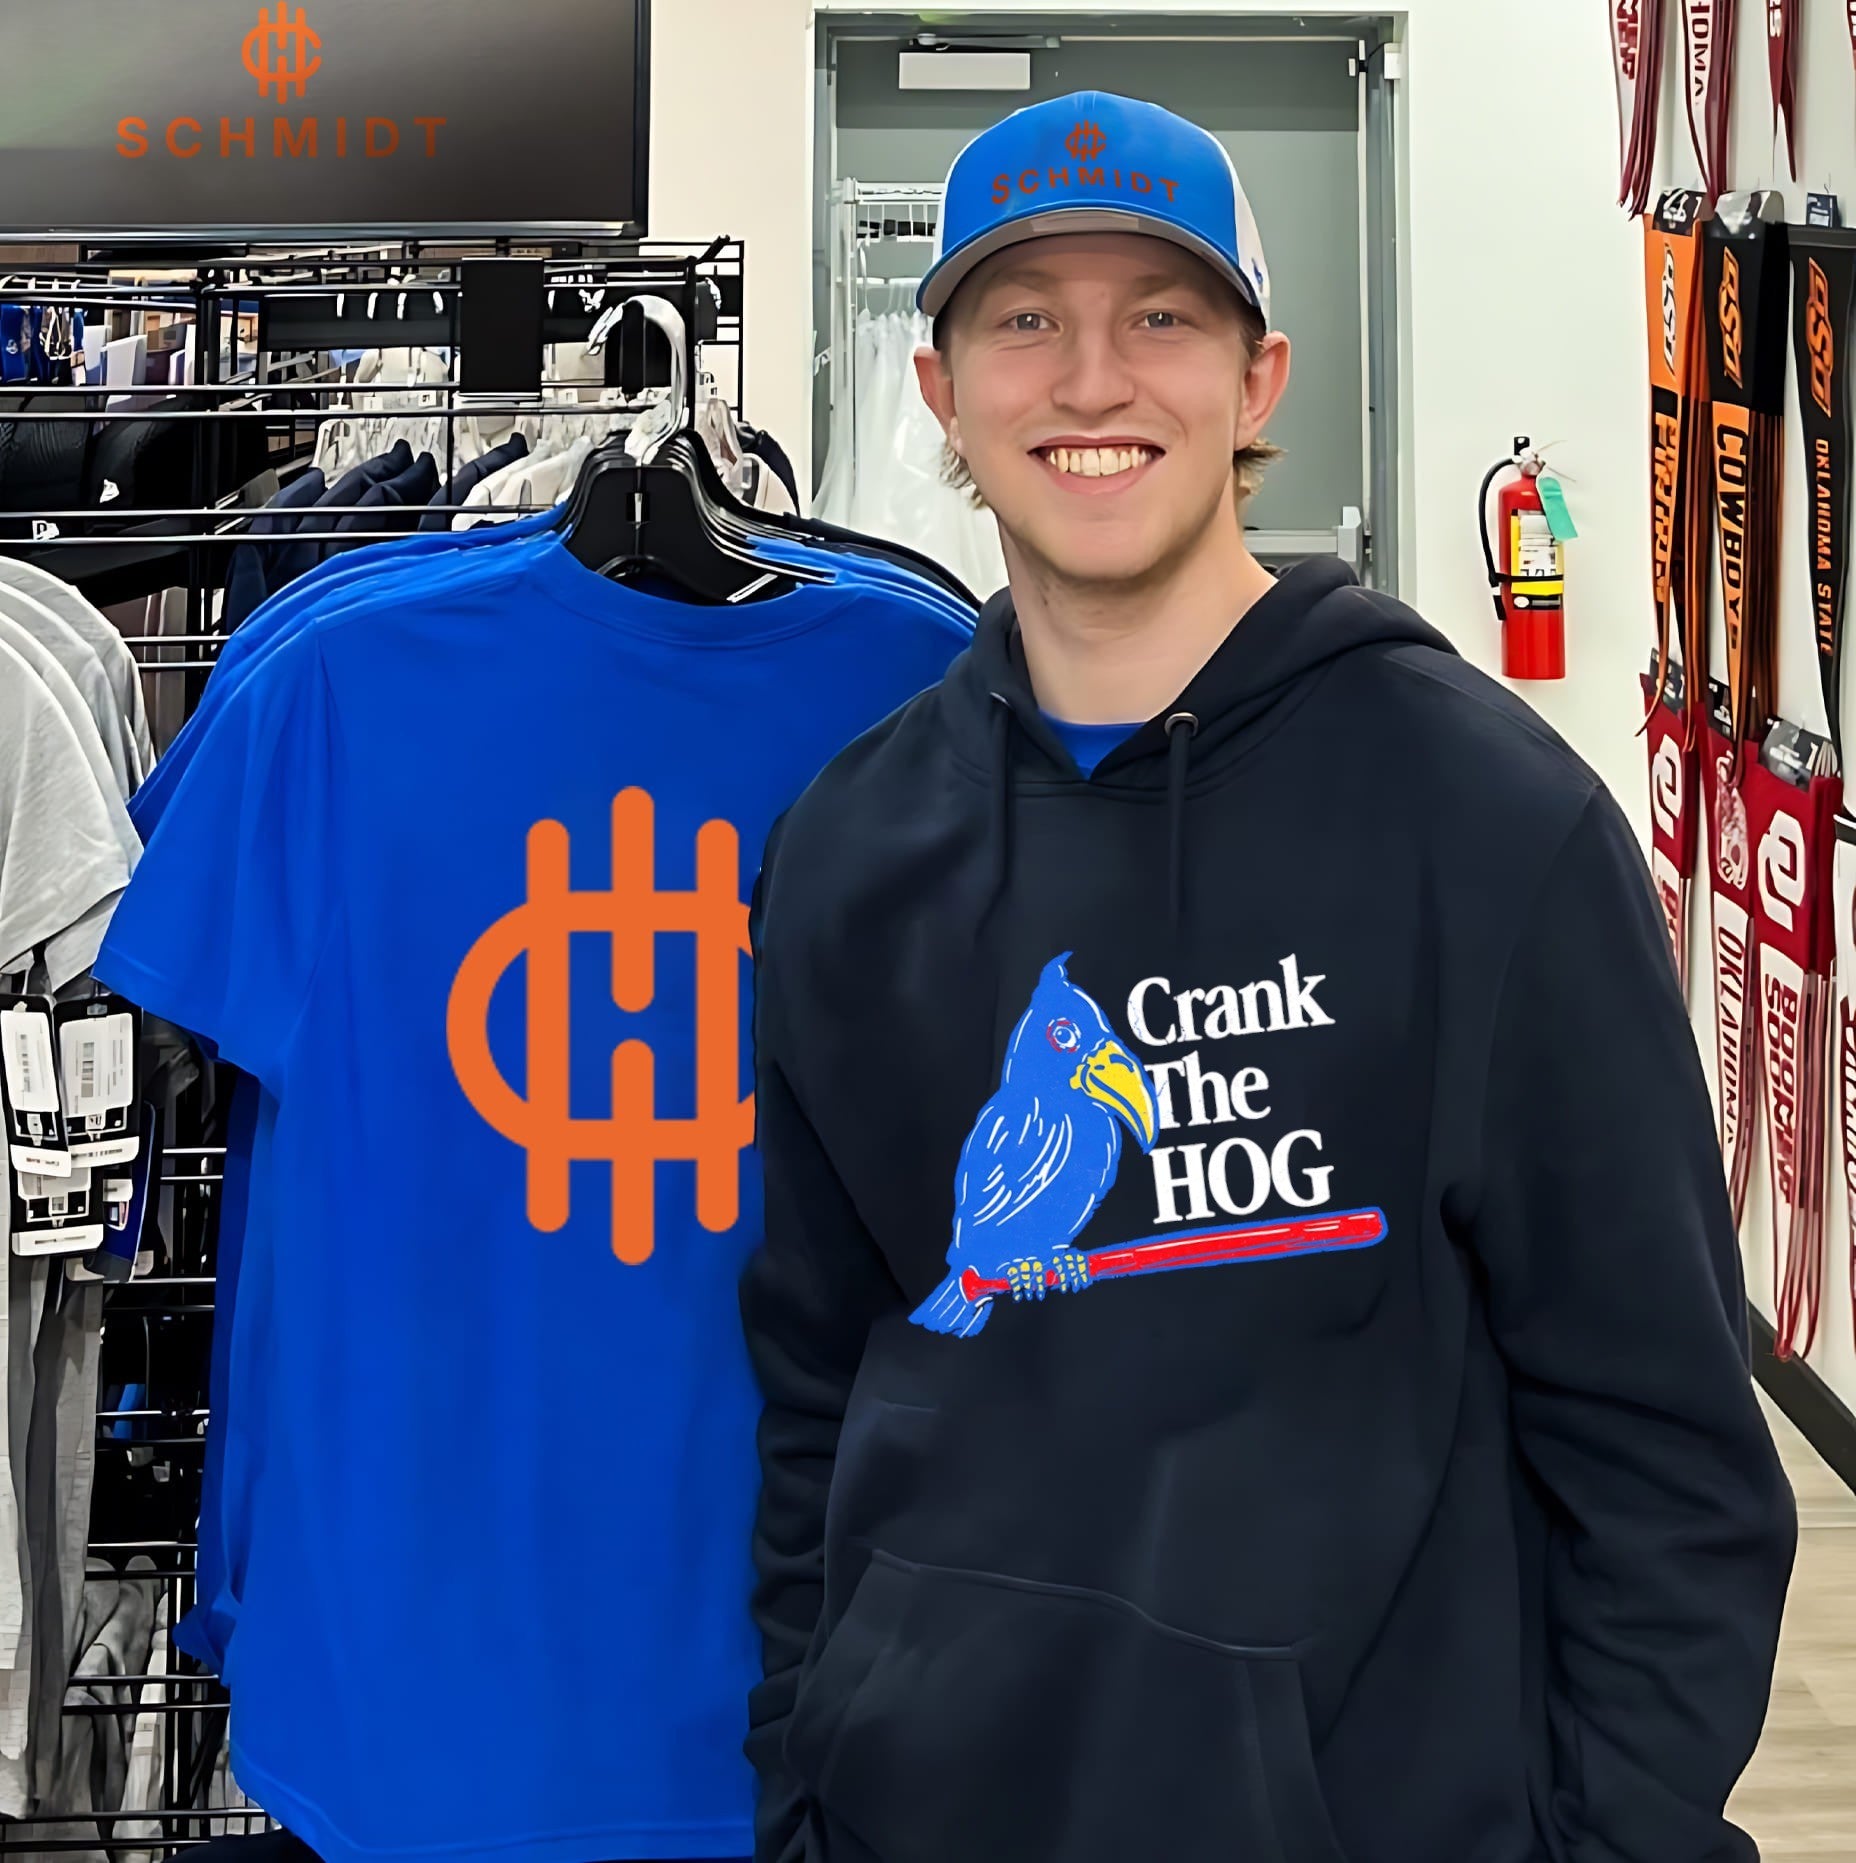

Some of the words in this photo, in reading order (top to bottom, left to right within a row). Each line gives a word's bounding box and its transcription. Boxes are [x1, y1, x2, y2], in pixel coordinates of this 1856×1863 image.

[115, 116, 448, 158] SCHMIDT
[990, 166, 1180, 205] SCHMIDT
[1815, 438, 1832, 570] OKLAHOMA
[1126, 953, 1336, 1047] Crank
[1143, 1050, 1272, 1130] The
[1150, 1128, 1335, 1224] HOG
